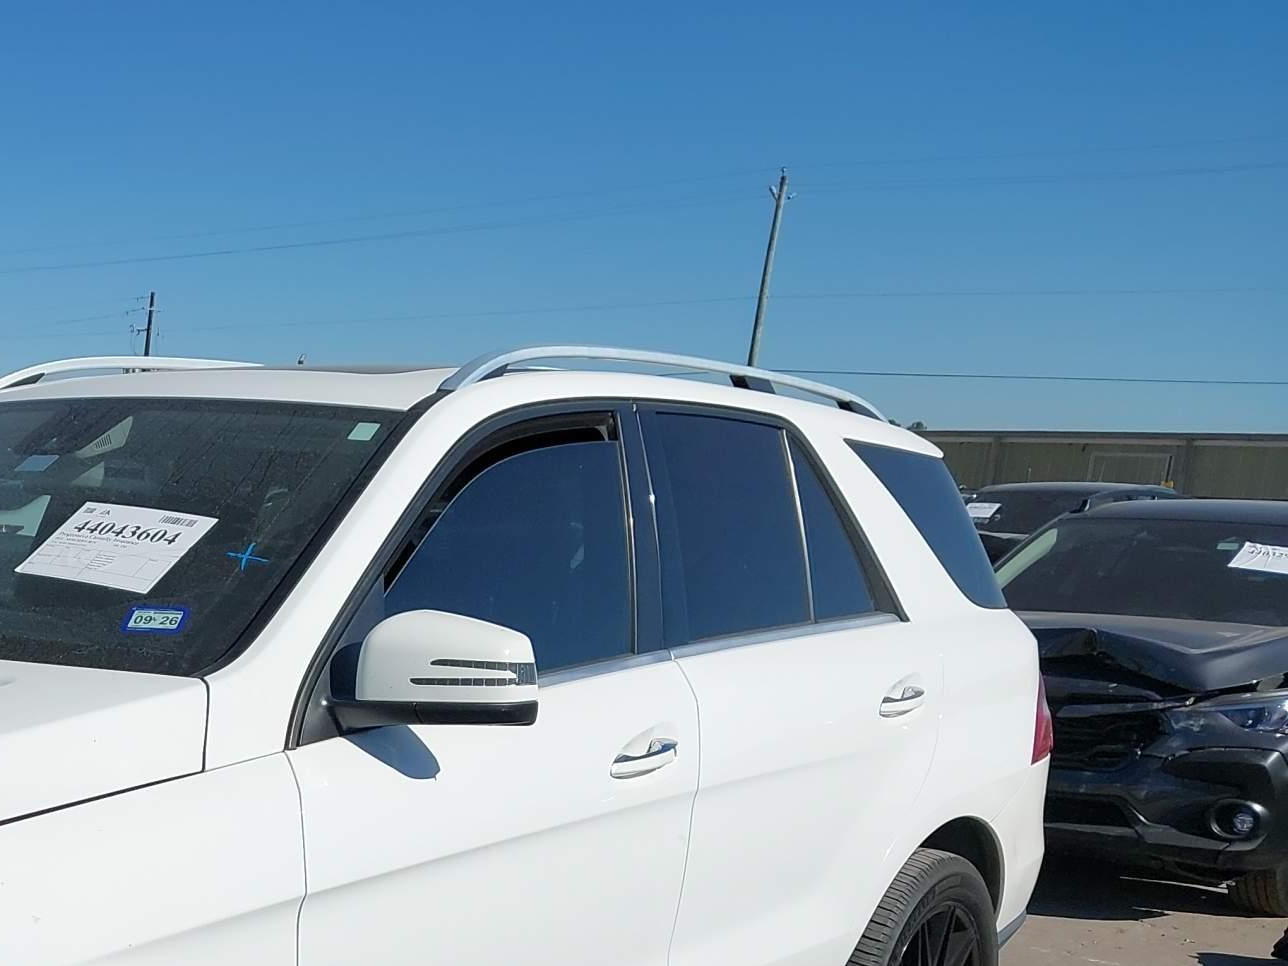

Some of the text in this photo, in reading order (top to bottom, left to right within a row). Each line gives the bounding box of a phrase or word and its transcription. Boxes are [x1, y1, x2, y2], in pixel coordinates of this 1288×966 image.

[74, 520, 182, 545] 44043604
[134, 615, 180, 626] 09 26
